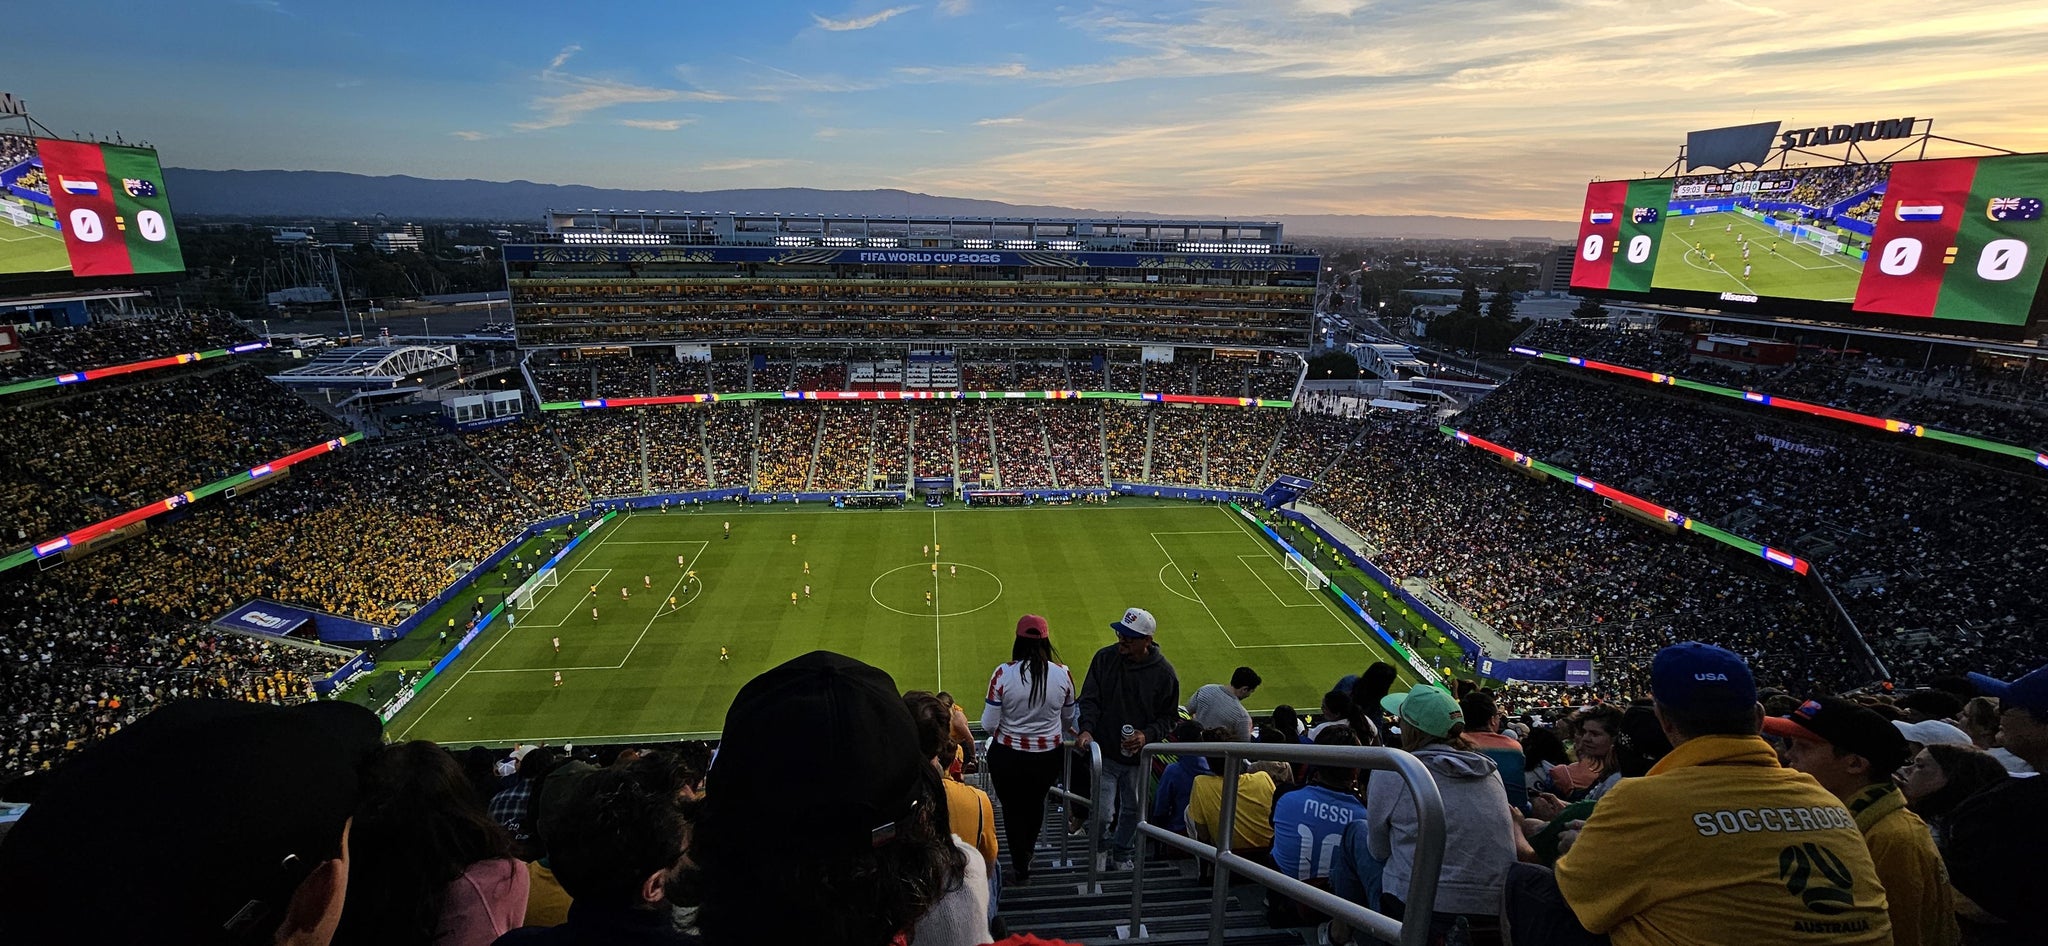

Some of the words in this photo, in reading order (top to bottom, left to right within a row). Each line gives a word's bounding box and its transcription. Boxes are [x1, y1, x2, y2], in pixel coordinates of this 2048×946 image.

[1780, 117, 1916, 149] STADIUM
[1682, 186, 1701, 194] 59:03
[70, 208, 104, 242] 0
[137, 210, 167, 242] 0
[860, 252, 886, 262] FIFA
[888, 253, 932, 262] WORLD
[934, 253, 957, 262] CUP
[959, 254, 1001, 263] 2026
[1583, 234, 1604, 262] 0
[1628, 234, 1652, 264] 0
[1880, 237, 1923, 276] 0
[1977, 239, 2028, 281] 0
[1720, 291, 1758, 303] Hisense
[1694, 673, 1729, 682] USA
[383, 689, 415, 721] aramco
[1304, 799, 1353, 825] MESSI
[1692, 806, 1854, 837] SOCCEROOS
[1792, 919, 1870, 934] AUSTRALIA
